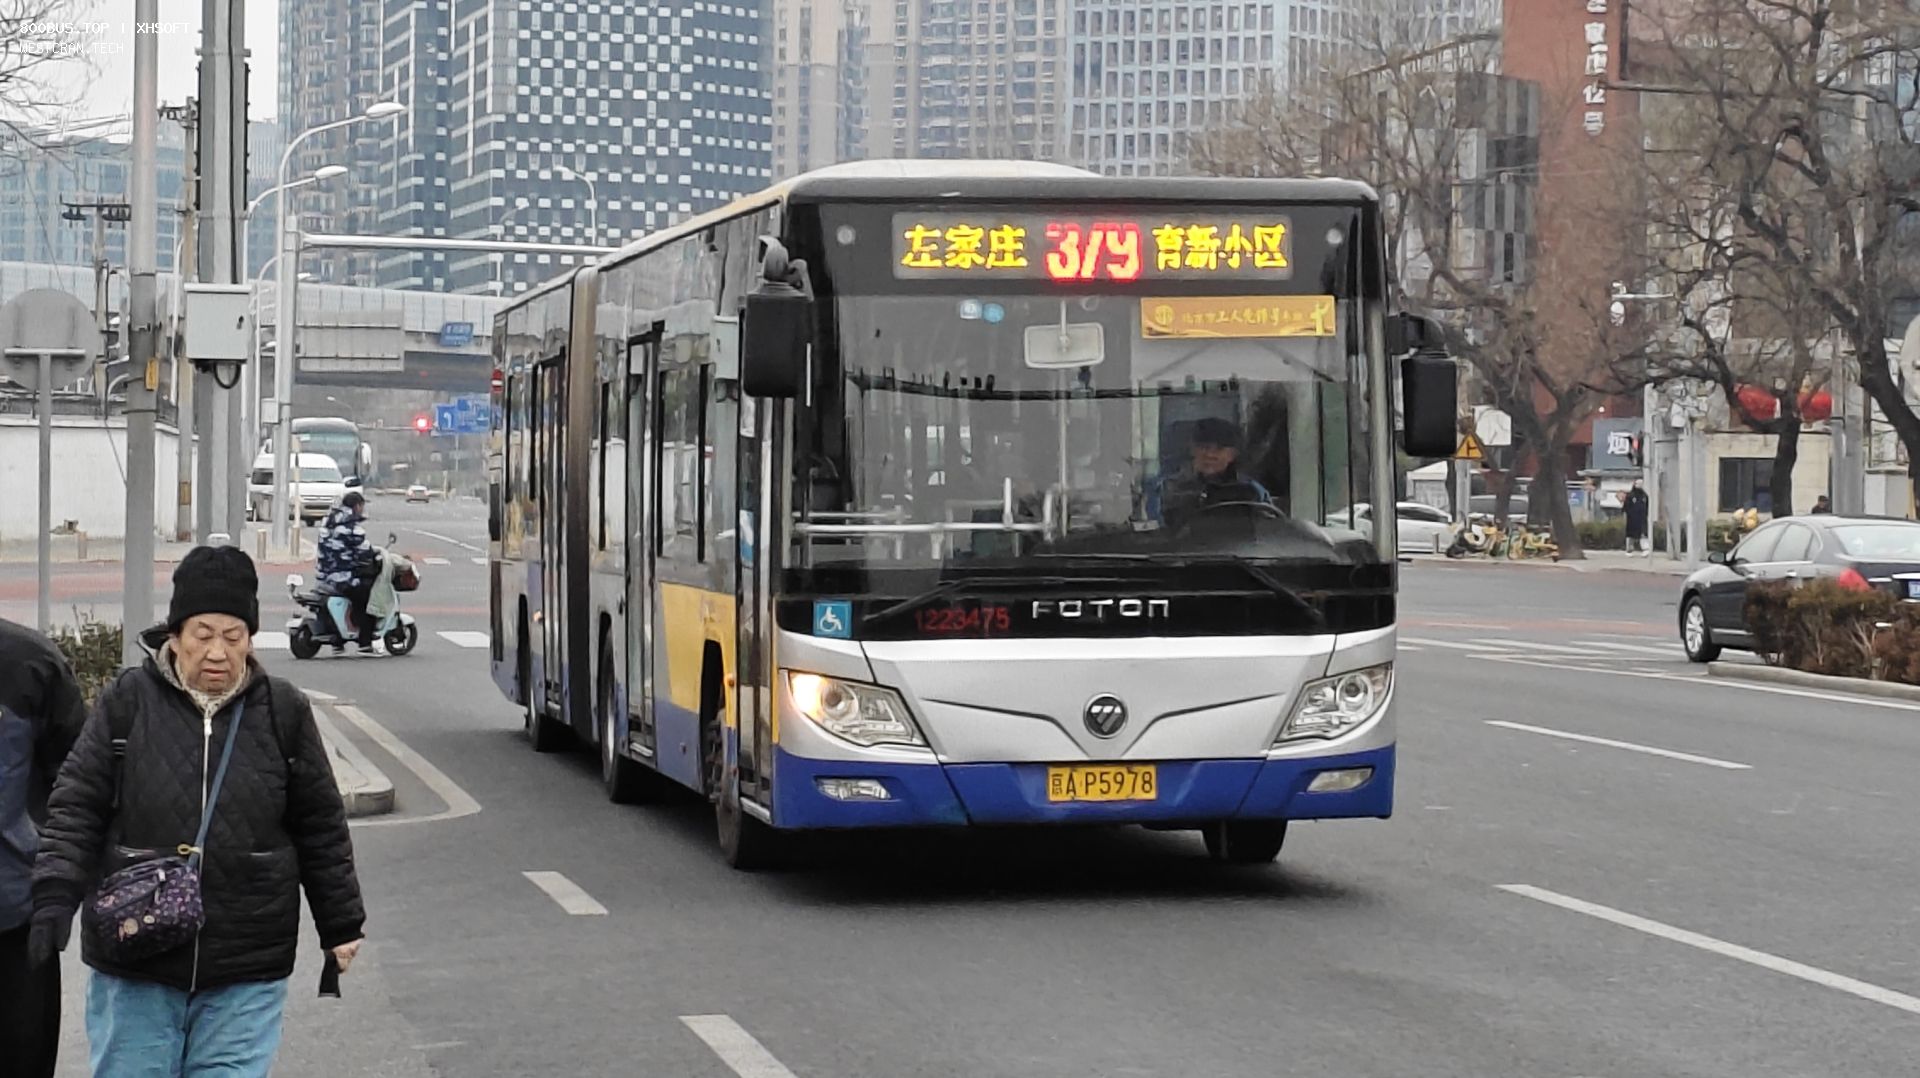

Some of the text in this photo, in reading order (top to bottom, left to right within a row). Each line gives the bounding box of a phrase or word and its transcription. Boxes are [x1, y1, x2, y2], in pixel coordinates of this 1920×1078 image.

[900, 224, 1029, 270] 左家庄
[1151, 223, 1289, 271] 育新小区
[914, 606, 1011, 634] 1223475
